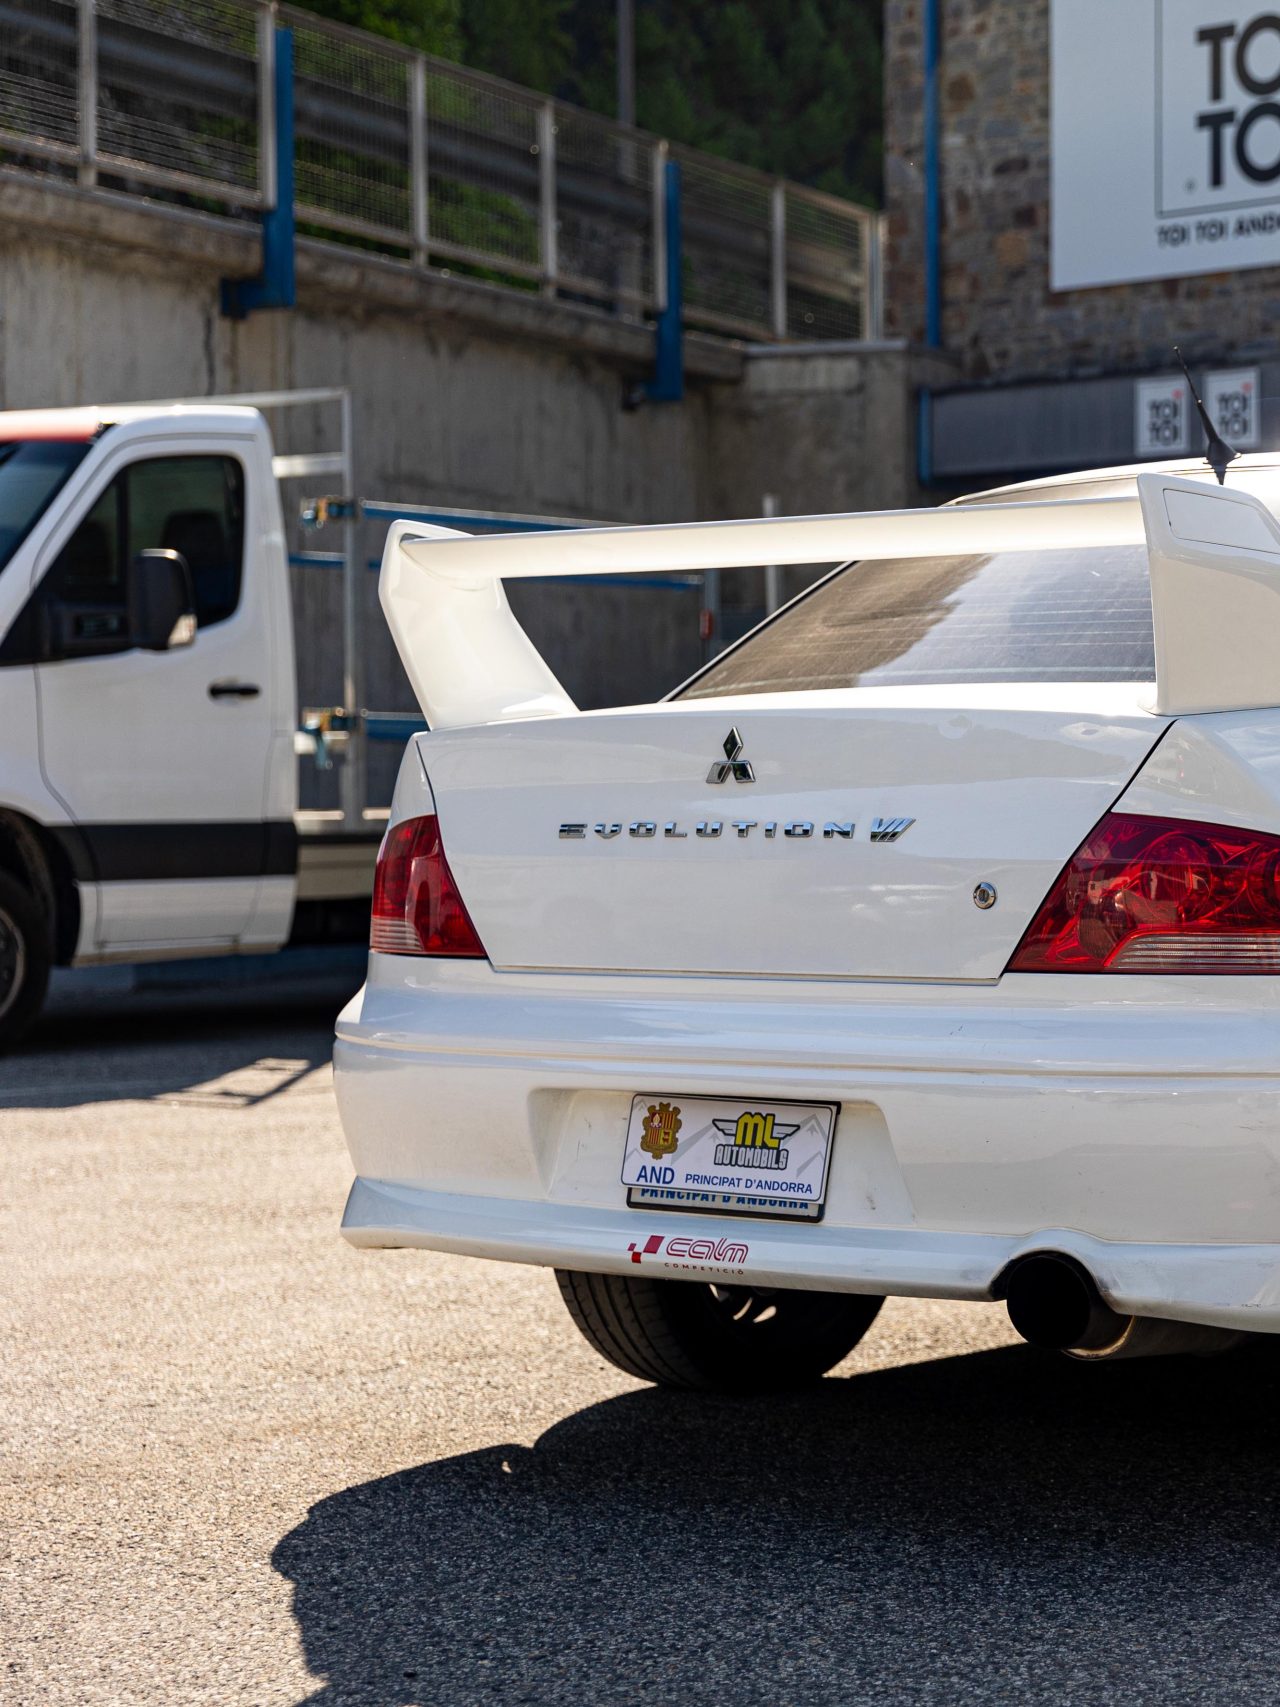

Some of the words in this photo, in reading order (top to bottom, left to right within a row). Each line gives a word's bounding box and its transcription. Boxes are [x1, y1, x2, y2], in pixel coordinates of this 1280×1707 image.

[1158, 225, 1188, 246] TOI
[1197, 219, 1226, 241] TOI
[558, 820, 856, 840] EVOLUTION
[735, 1112, 781, 1149] ML
[636, 1164, 675, 1185] AND
[685, 1173, 743, 1189] PRINCIPAT
[744, 1178, 813, 1195] D'ANDORRA
[666, 1237, 749, 1264] calm
